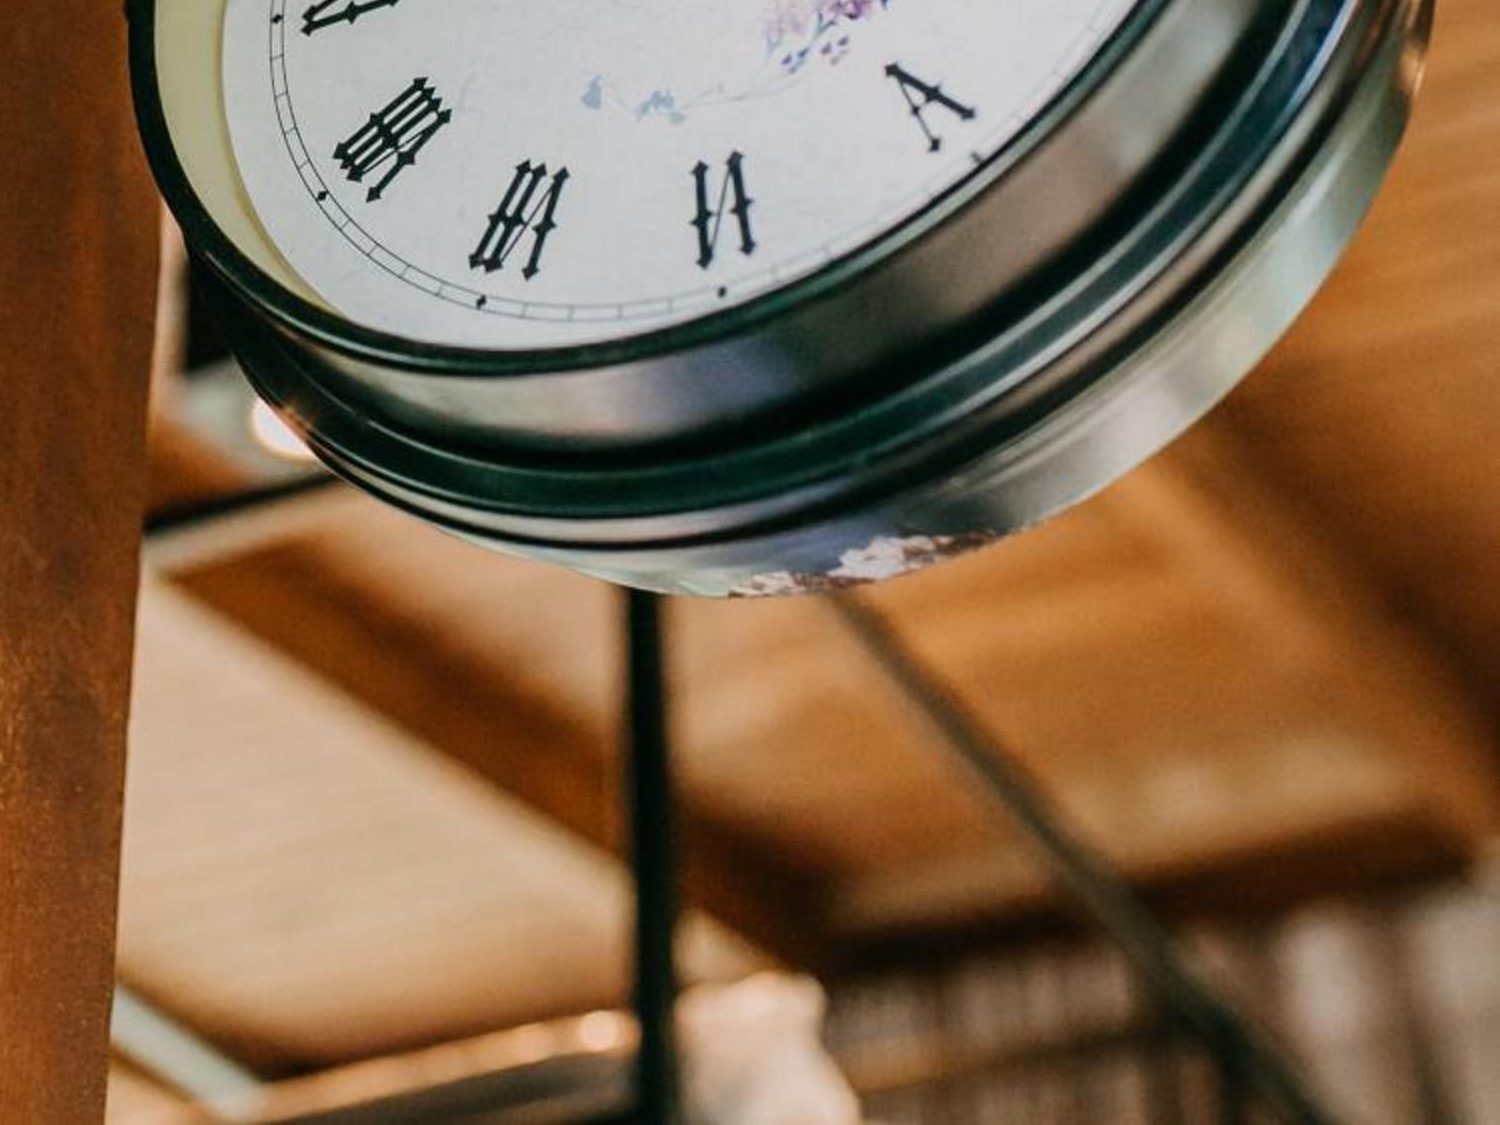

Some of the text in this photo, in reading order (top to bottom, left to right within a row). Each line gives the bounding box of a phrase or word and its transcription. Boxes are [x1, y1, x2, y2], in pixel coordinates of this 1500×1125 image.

[332, 77, 452, 203] VIII
[885, 64, 975, 152] V
[469, 160, 569, 280] VII
[691, 151, 756, 269] VI
